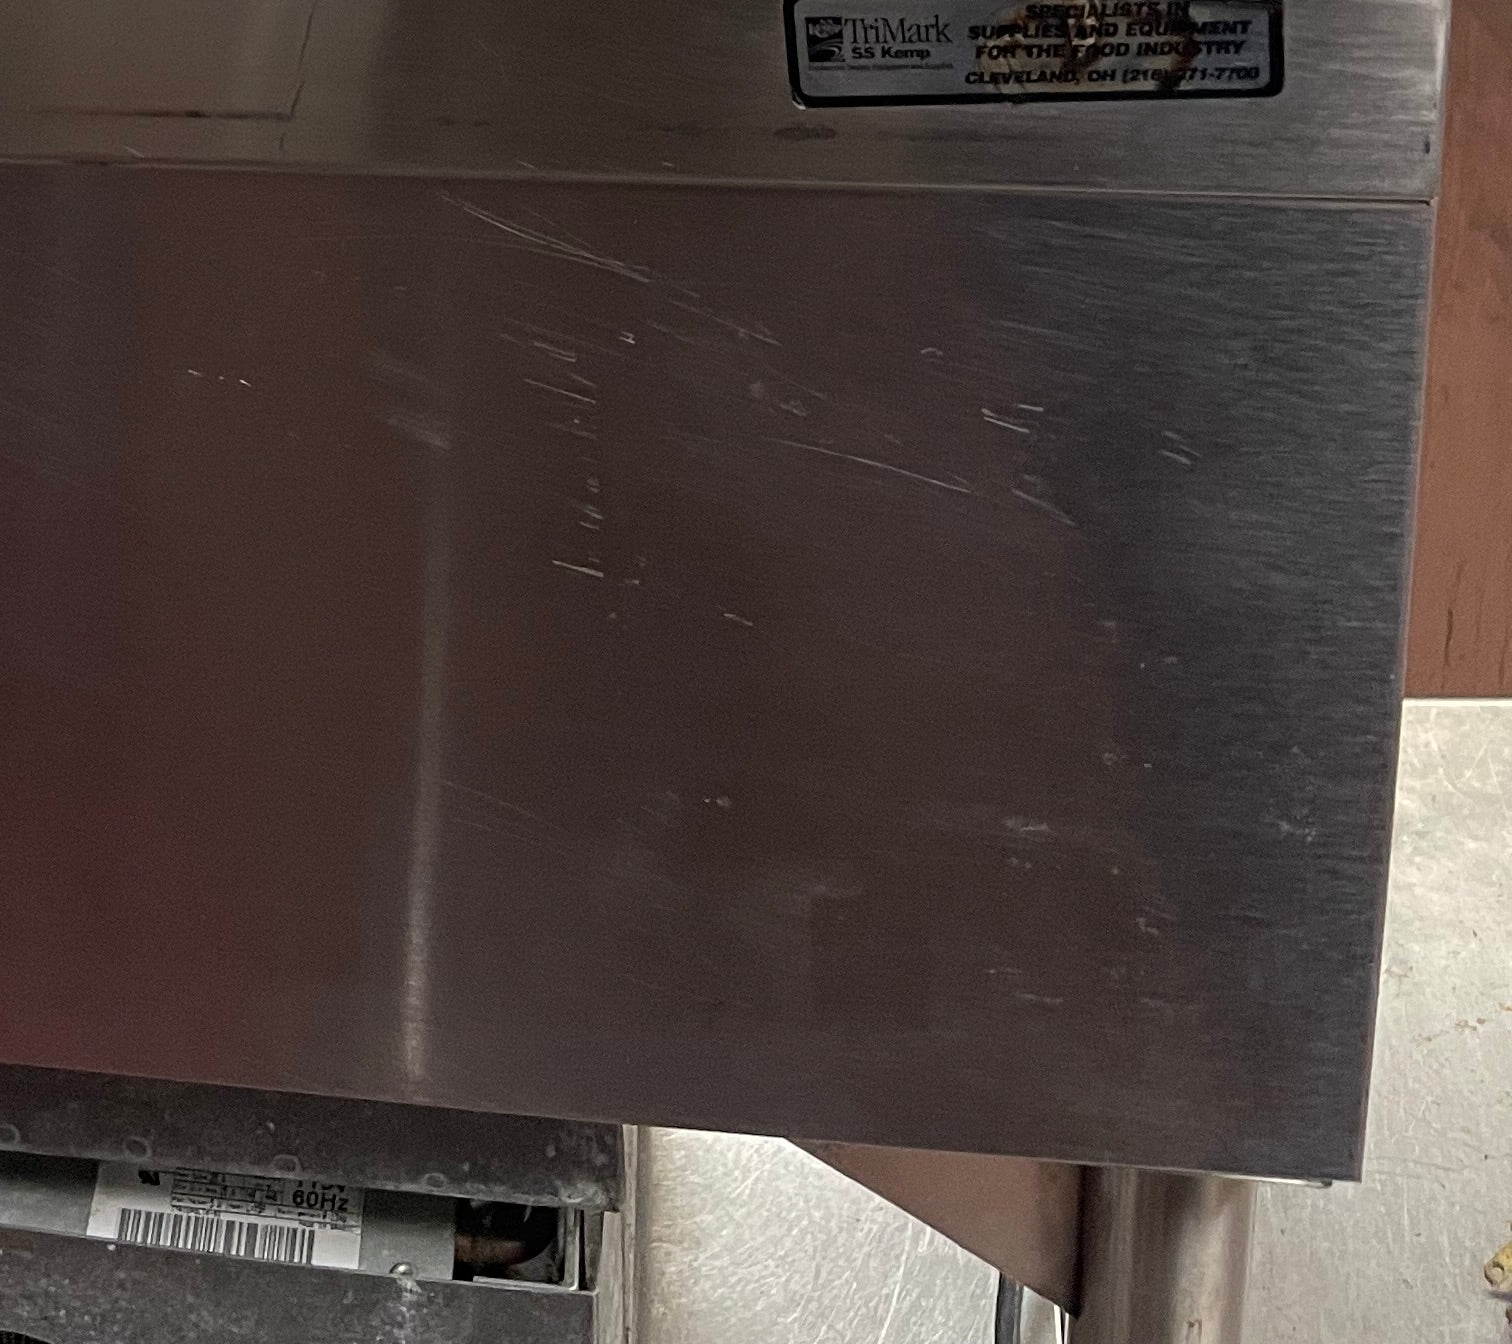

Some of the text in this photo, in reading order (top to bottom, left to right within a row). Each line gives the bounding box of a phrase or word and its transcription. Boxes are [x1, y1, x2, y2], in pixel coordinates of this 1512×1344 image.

[844, 14, 954, 44] TriMark
[1074, 21, 1119, 39] AND
[851, 45, 932, 61] SS Kemp
[1026, 43, 1066, 59] THE
[1088, 68, 1117, 82] OH
[291, 1188, 349, 1213] 60Hz
